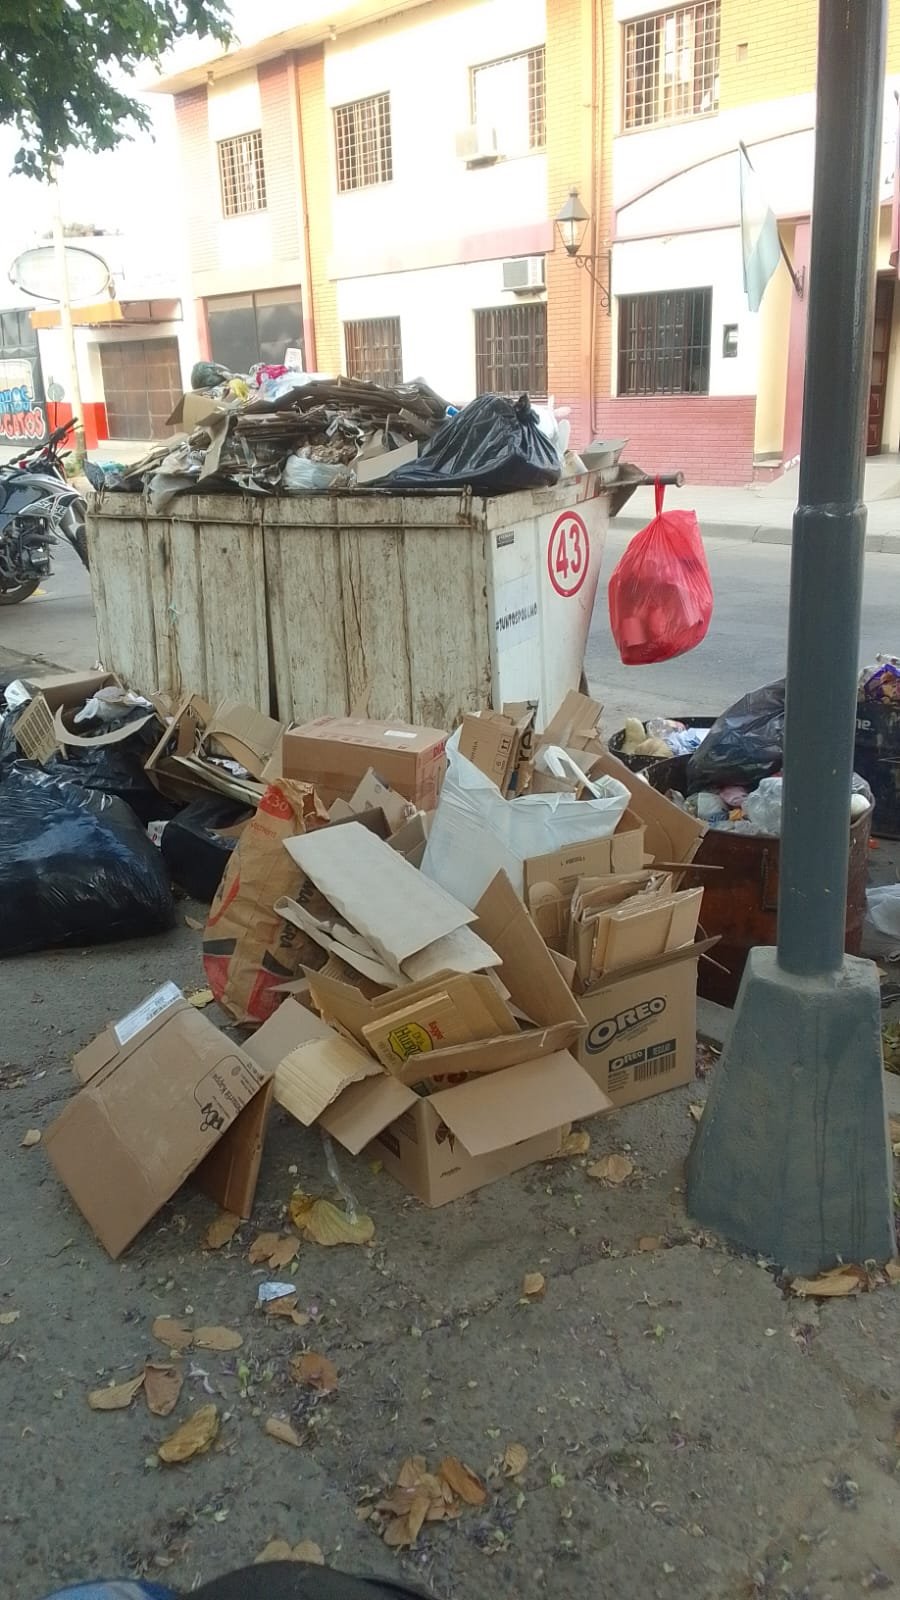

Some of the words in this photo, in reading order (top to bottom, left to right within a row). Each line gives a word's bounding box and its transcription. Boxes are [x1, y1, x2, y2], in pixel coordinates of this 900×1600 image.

[556, 523, 581, 578] 43
[585, 997, 666, 1055] OREO
[611, 1051, 643, 1070] OREO
